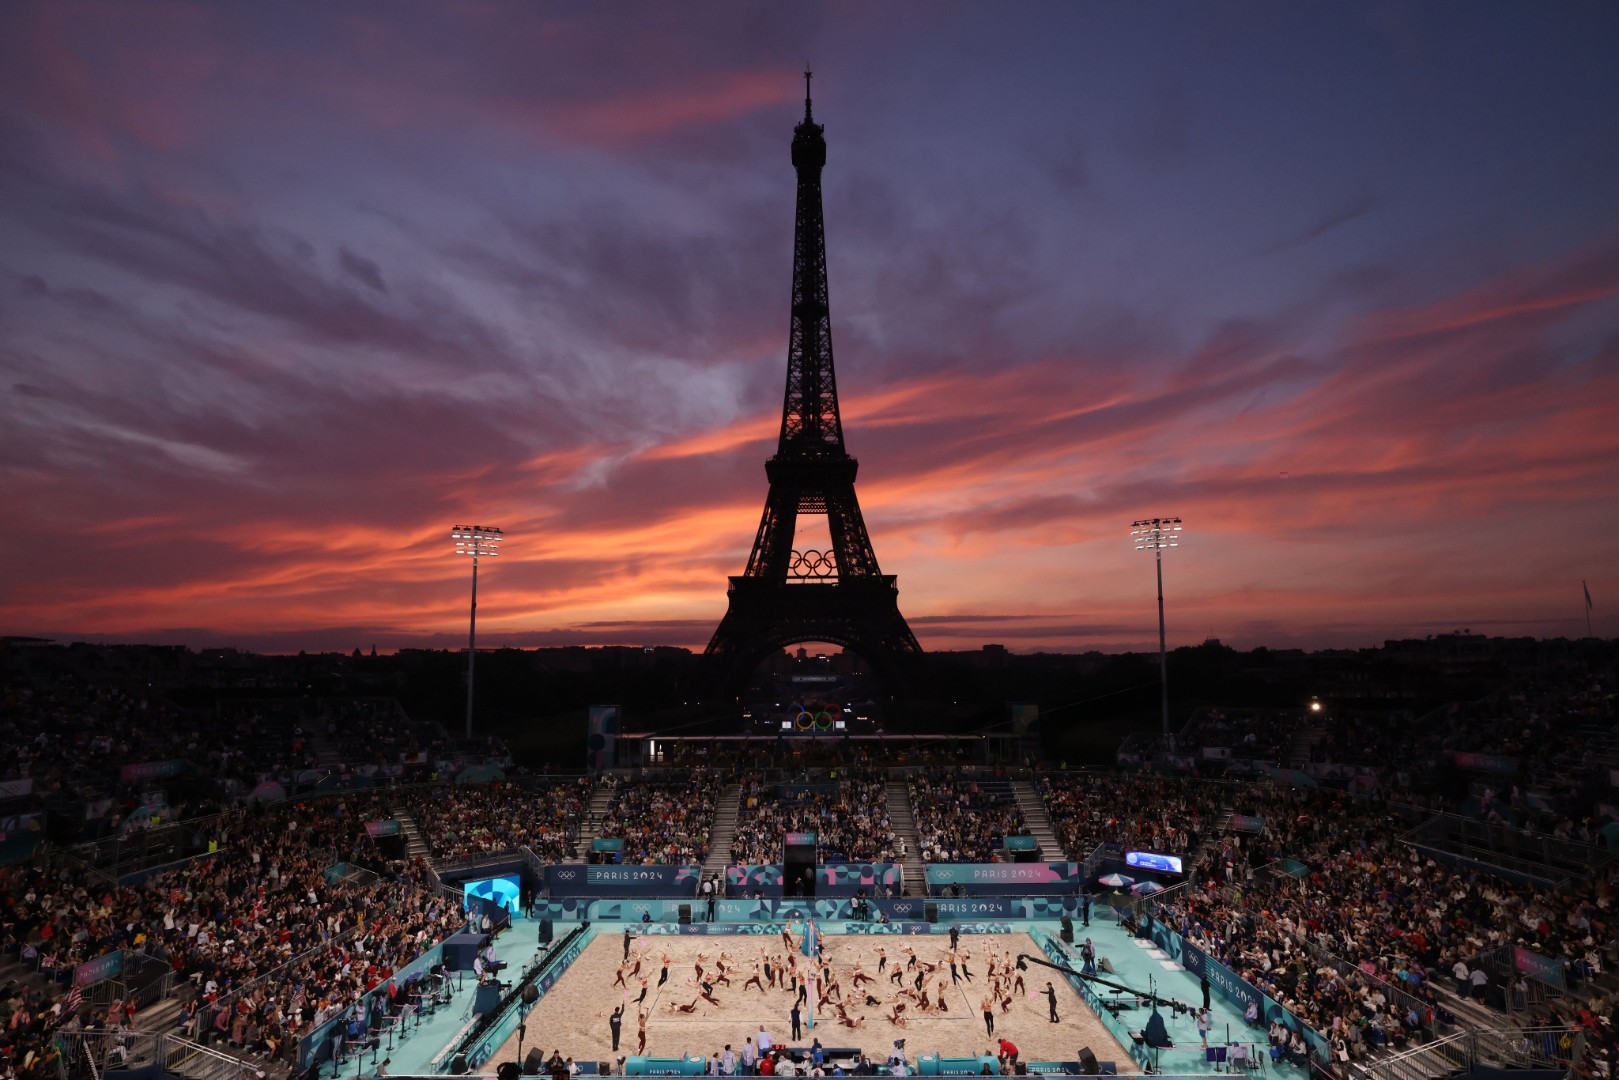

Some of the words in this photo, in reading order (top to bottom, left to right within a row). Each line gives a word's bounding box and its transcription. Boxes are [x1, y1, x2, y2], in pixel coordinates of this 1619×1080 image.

[596, 871, 629, 880] PARIS
[634, 871, 663, 880] 2024
[974, 870, 1008, 879] PARIS
[1011, 869, 1041, 879] 2024
[671, 904, 705, 912] PIS
[971, 903, 1003, 912] 2024
[1210, 968, 1233, 993] PARIS
